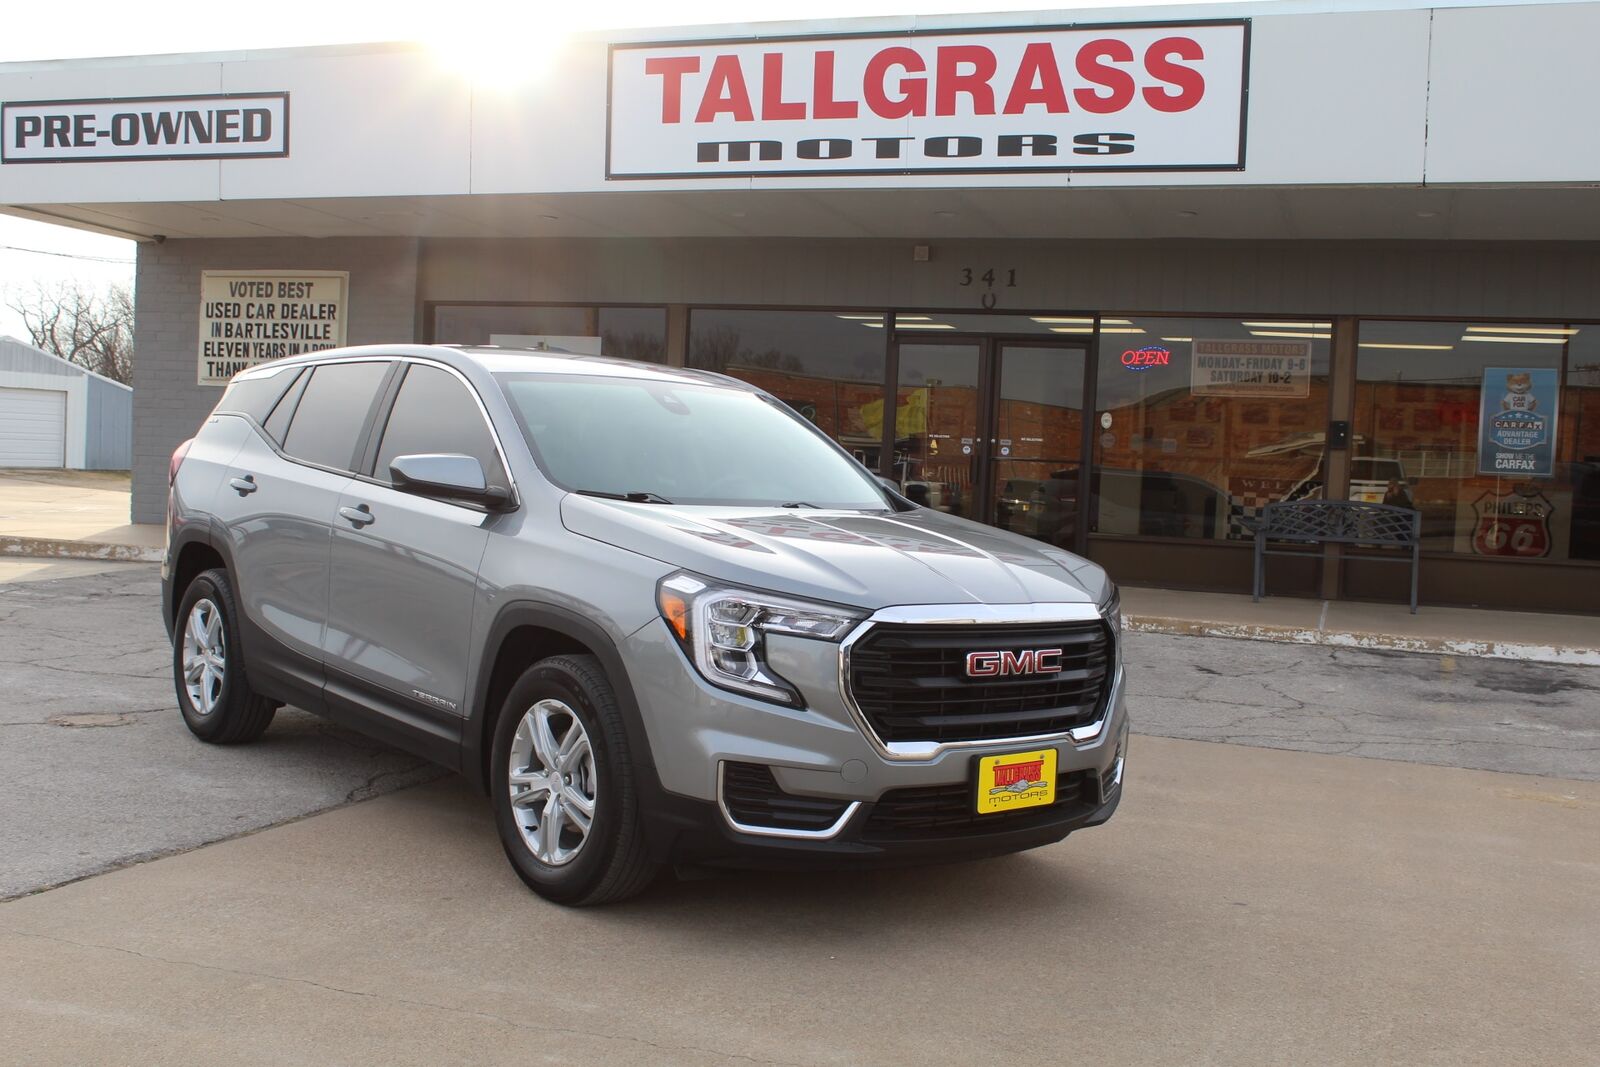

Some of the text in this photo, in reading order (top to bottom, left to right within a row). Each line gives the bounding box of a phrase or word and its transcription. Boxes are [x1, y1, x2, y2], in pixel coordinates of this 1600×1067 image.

[644, 36, 1206, 125] TALLGRASS
[15, 108, 273, 149] PRE-OWNED
[696, 132, 1136, 163] MOTORS
[229, 281, 314, 299] VOTED BEST
[205, 302, 337, 320] USED CAR DEALER
[211, 322, 331, 340] IN BARTLESVILLE
[204, 341, 250, 358] ELEVEN
[253, 342, 286, 359] YEARS
[288, 343, 300, 356] IN
[1199, 343, 1305, 354] TALLGRASS MOTORS
[1121, 350, 1170, 366] OPEN
[1197, 356, 1284, 370] MONDAY-FRIDAY
[206, 361, 249, 377] THANK
[1210, 370, 1292, 384] SATURDAY 10-2
[1495, 421, 1543, 430] CARFAX
[1497, 430, 1539, 439] ADVANTAGE
[1503, 437, 1531, 445] DEALER
[1495, 459, 1535, 469] CARFAX
[1484, 502, 1544, 516] PHILPS
[1485, 522, 1537, 550] 66
[966, 649, 1062, 677] GMC
[988, 790, 1049, 805] MOTORS
